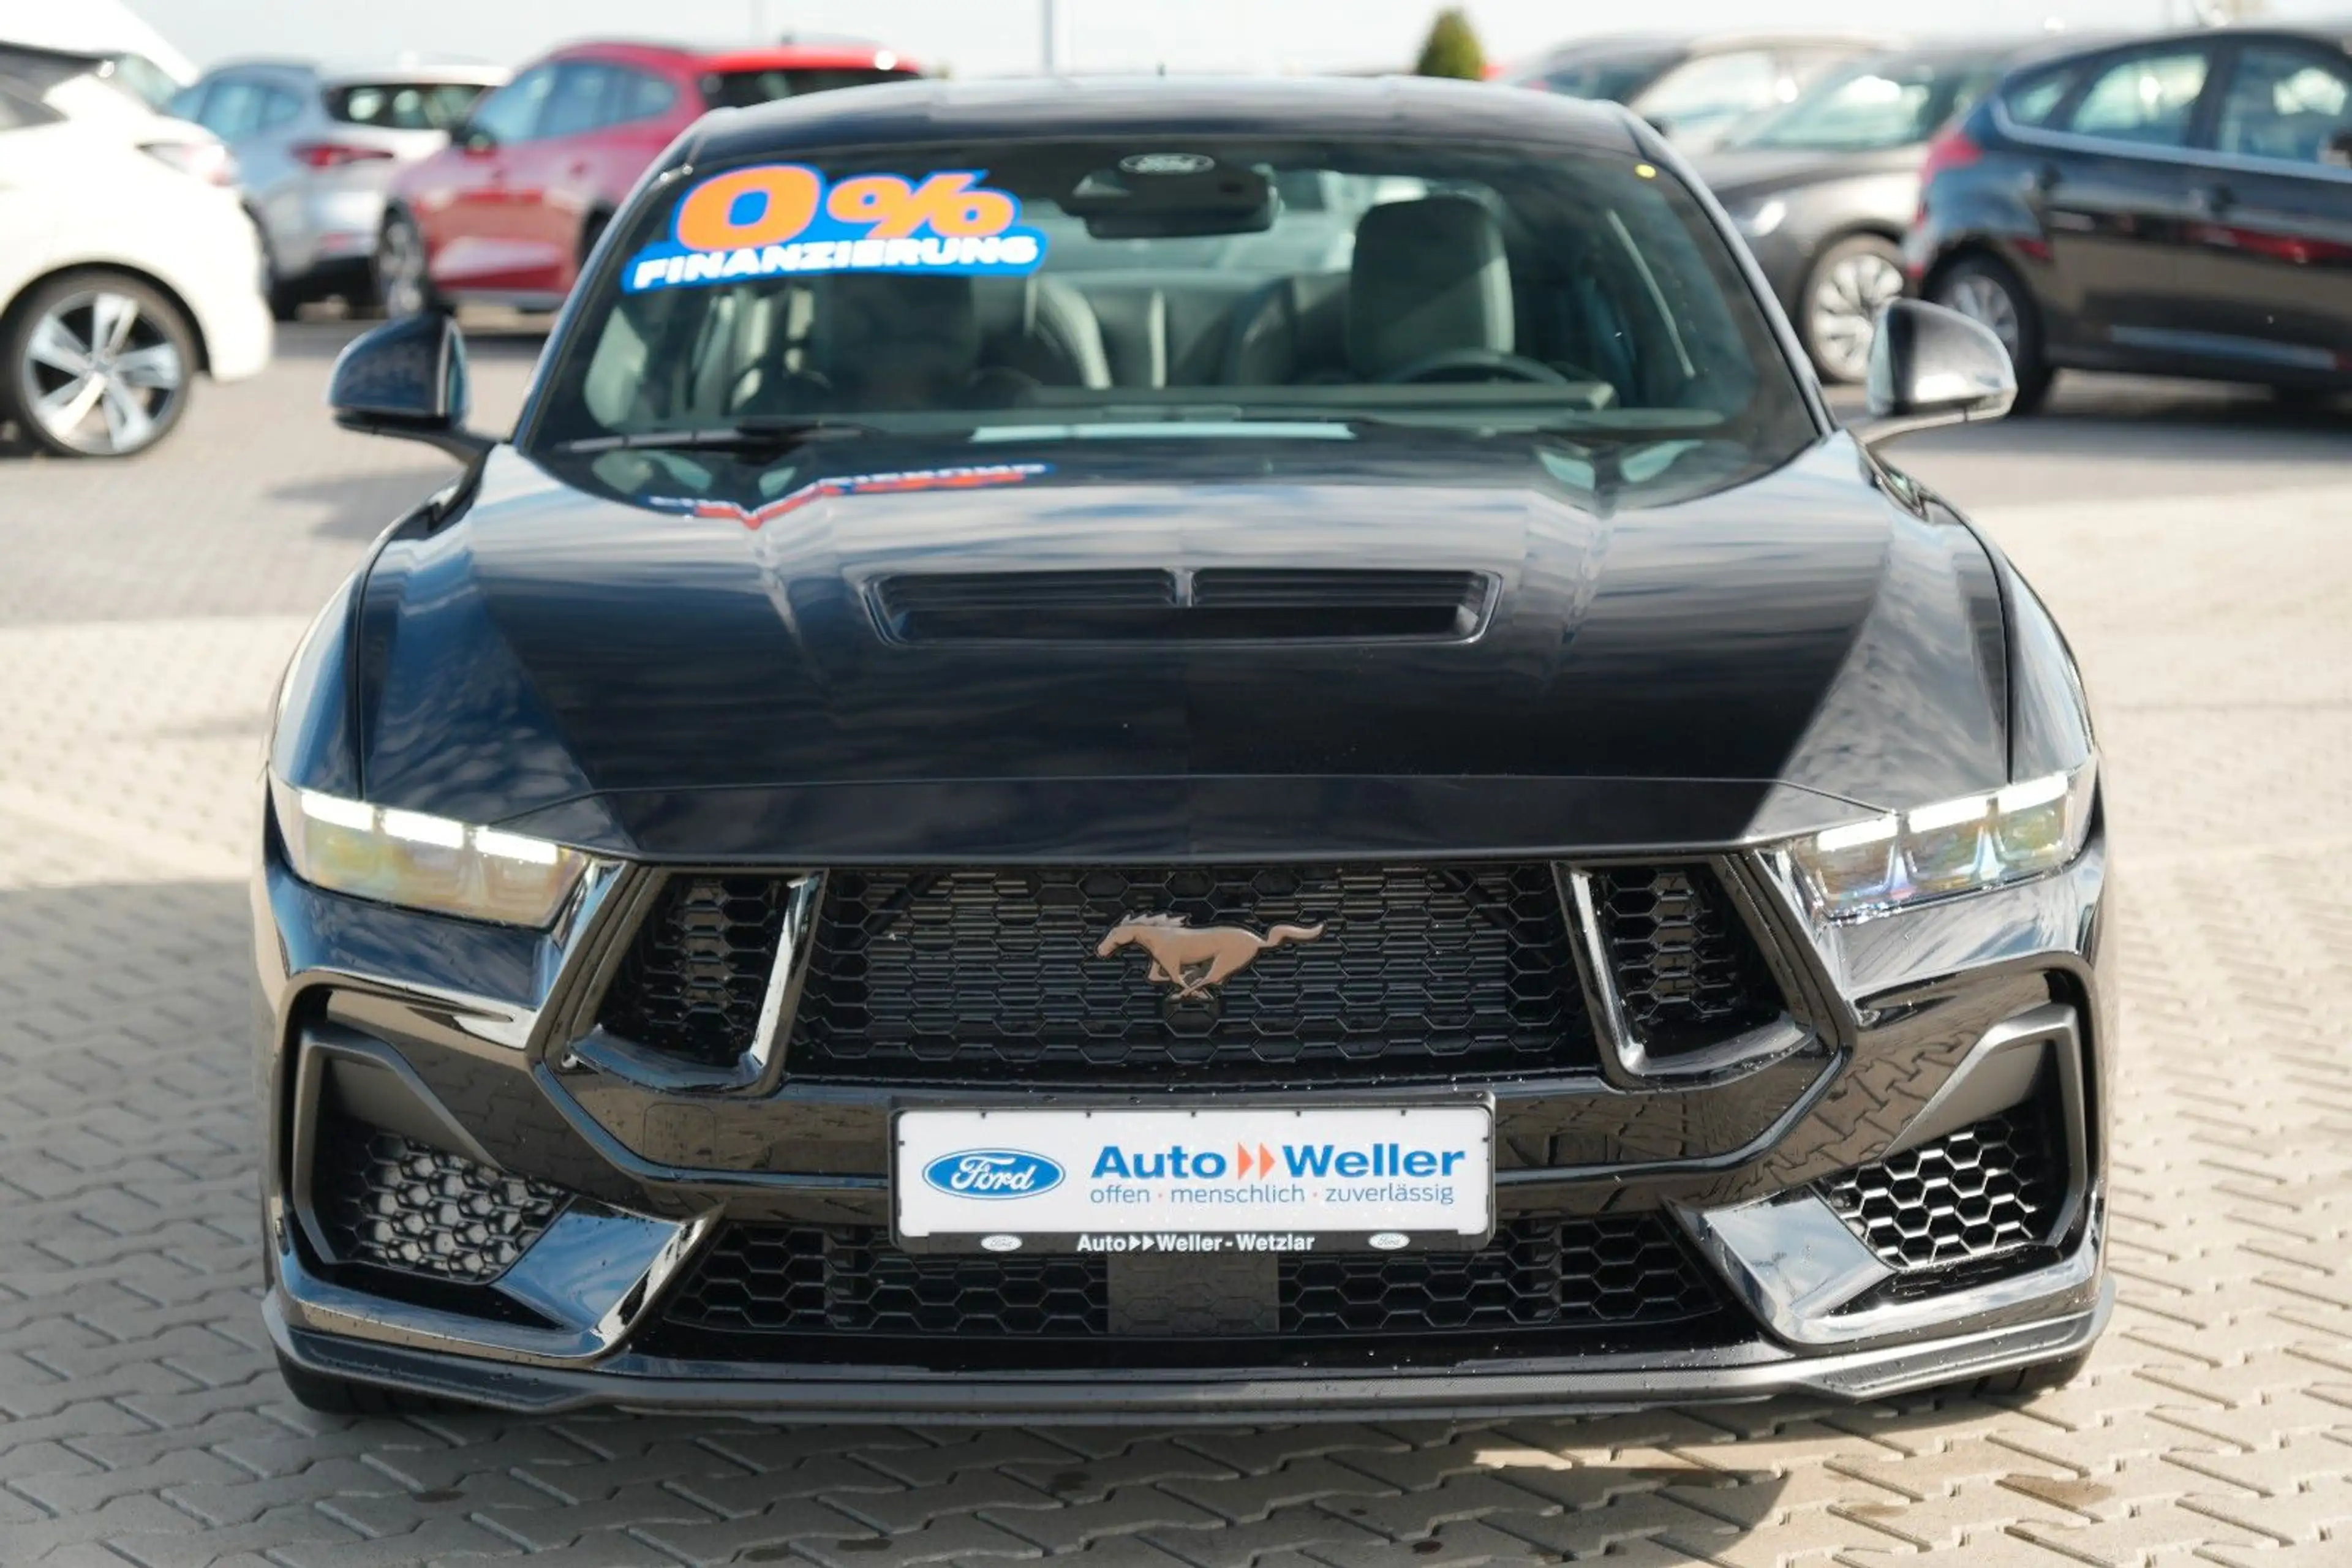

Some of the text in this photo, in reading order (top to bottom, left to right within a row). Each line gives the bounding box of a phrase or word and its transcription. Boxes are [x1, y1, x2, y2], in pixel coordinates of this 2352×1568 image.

[679, 165, 1014, 251] 0%
[633, 235, 1039, 289] FINANZIERUNG
[951, 1156, 1037, 1190] Ford
[1091, 1142, 1466, 1179] Auto Weller
[1090, 1183, 1454, 1204] offen menschlich zuverlässig
[1076, 1234, 1127, 1252] Auto
